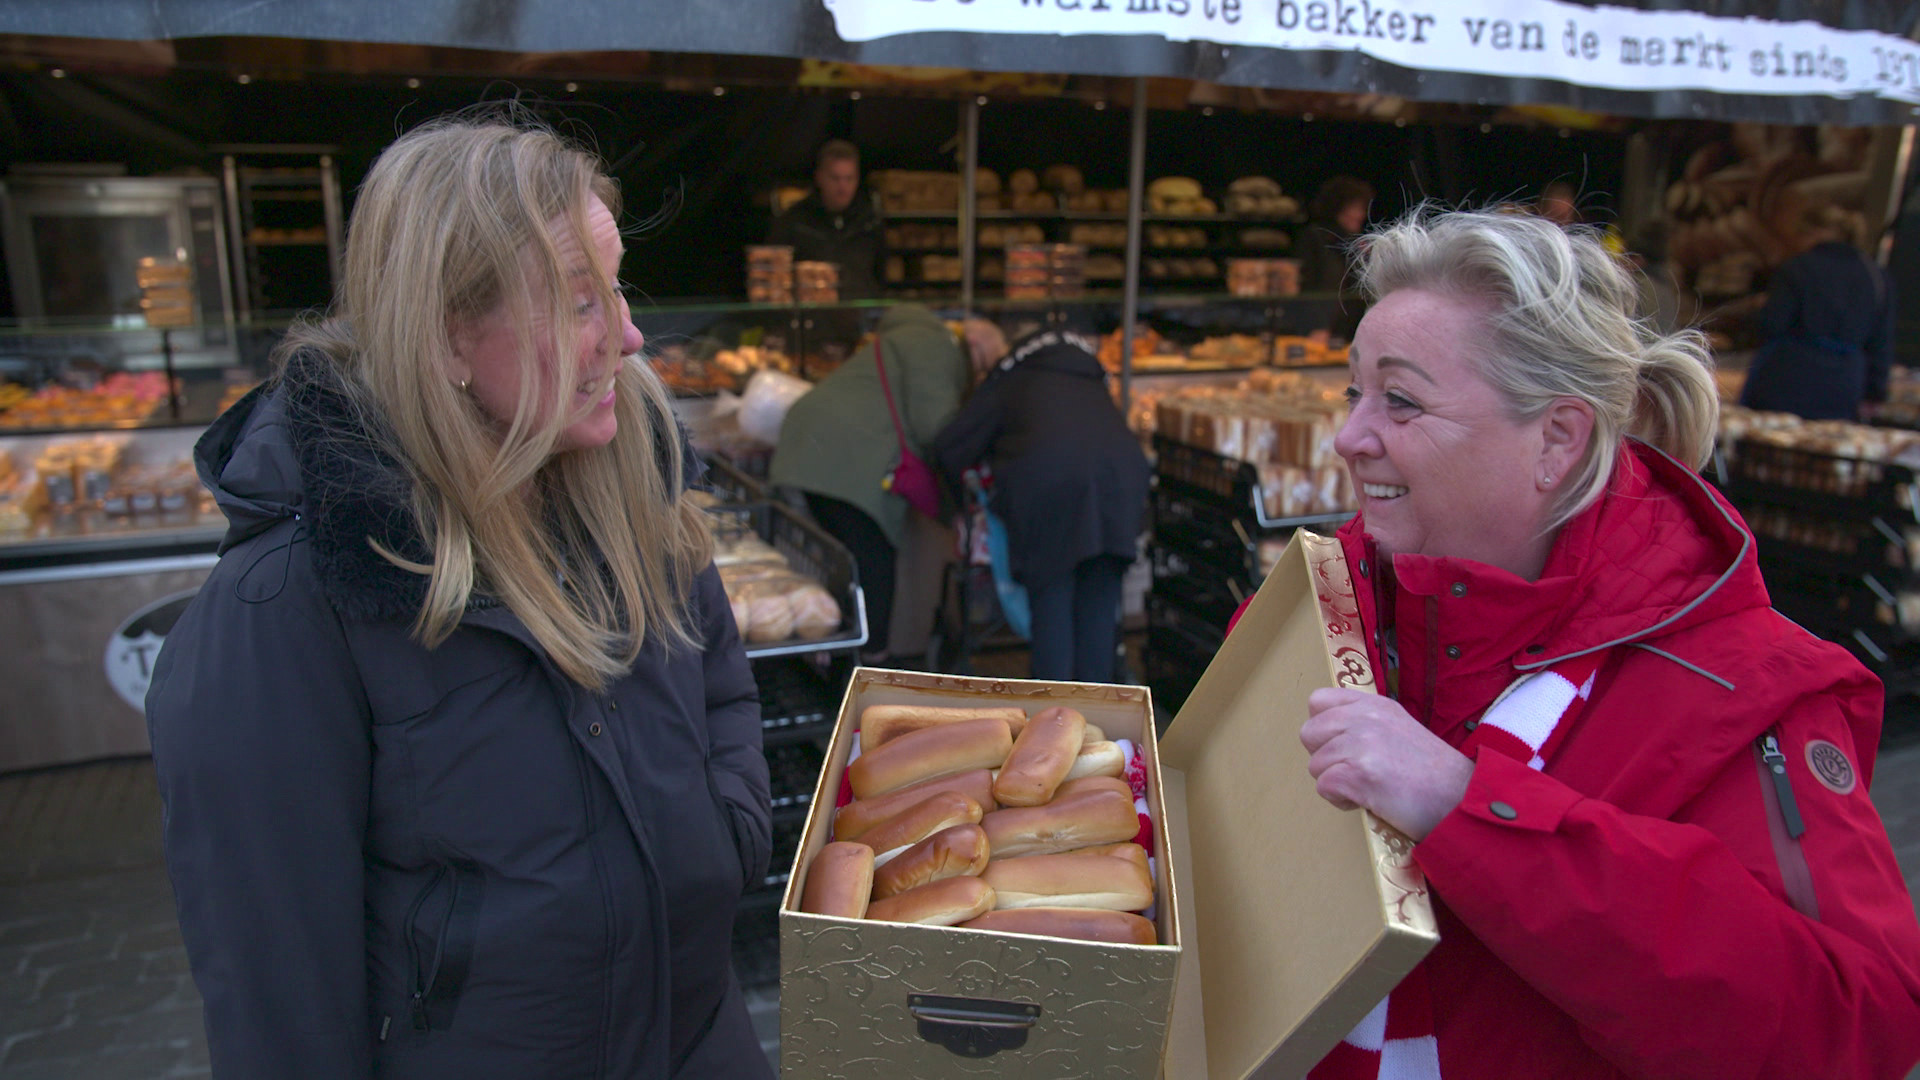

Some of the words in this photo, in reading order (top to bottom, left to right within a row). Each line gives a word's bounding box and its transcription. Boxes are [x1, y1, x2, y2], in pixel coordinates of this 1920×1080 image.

[1020, 0, 1242, 24] mste
[1276, 0, 1435, 43] bakker
[1463, 17, 1545, 51] van
[1563, 19, 1600, 60] de
[1620, 31, 1731, 72] markt
[1750, 41, 1848, 82] sinds
